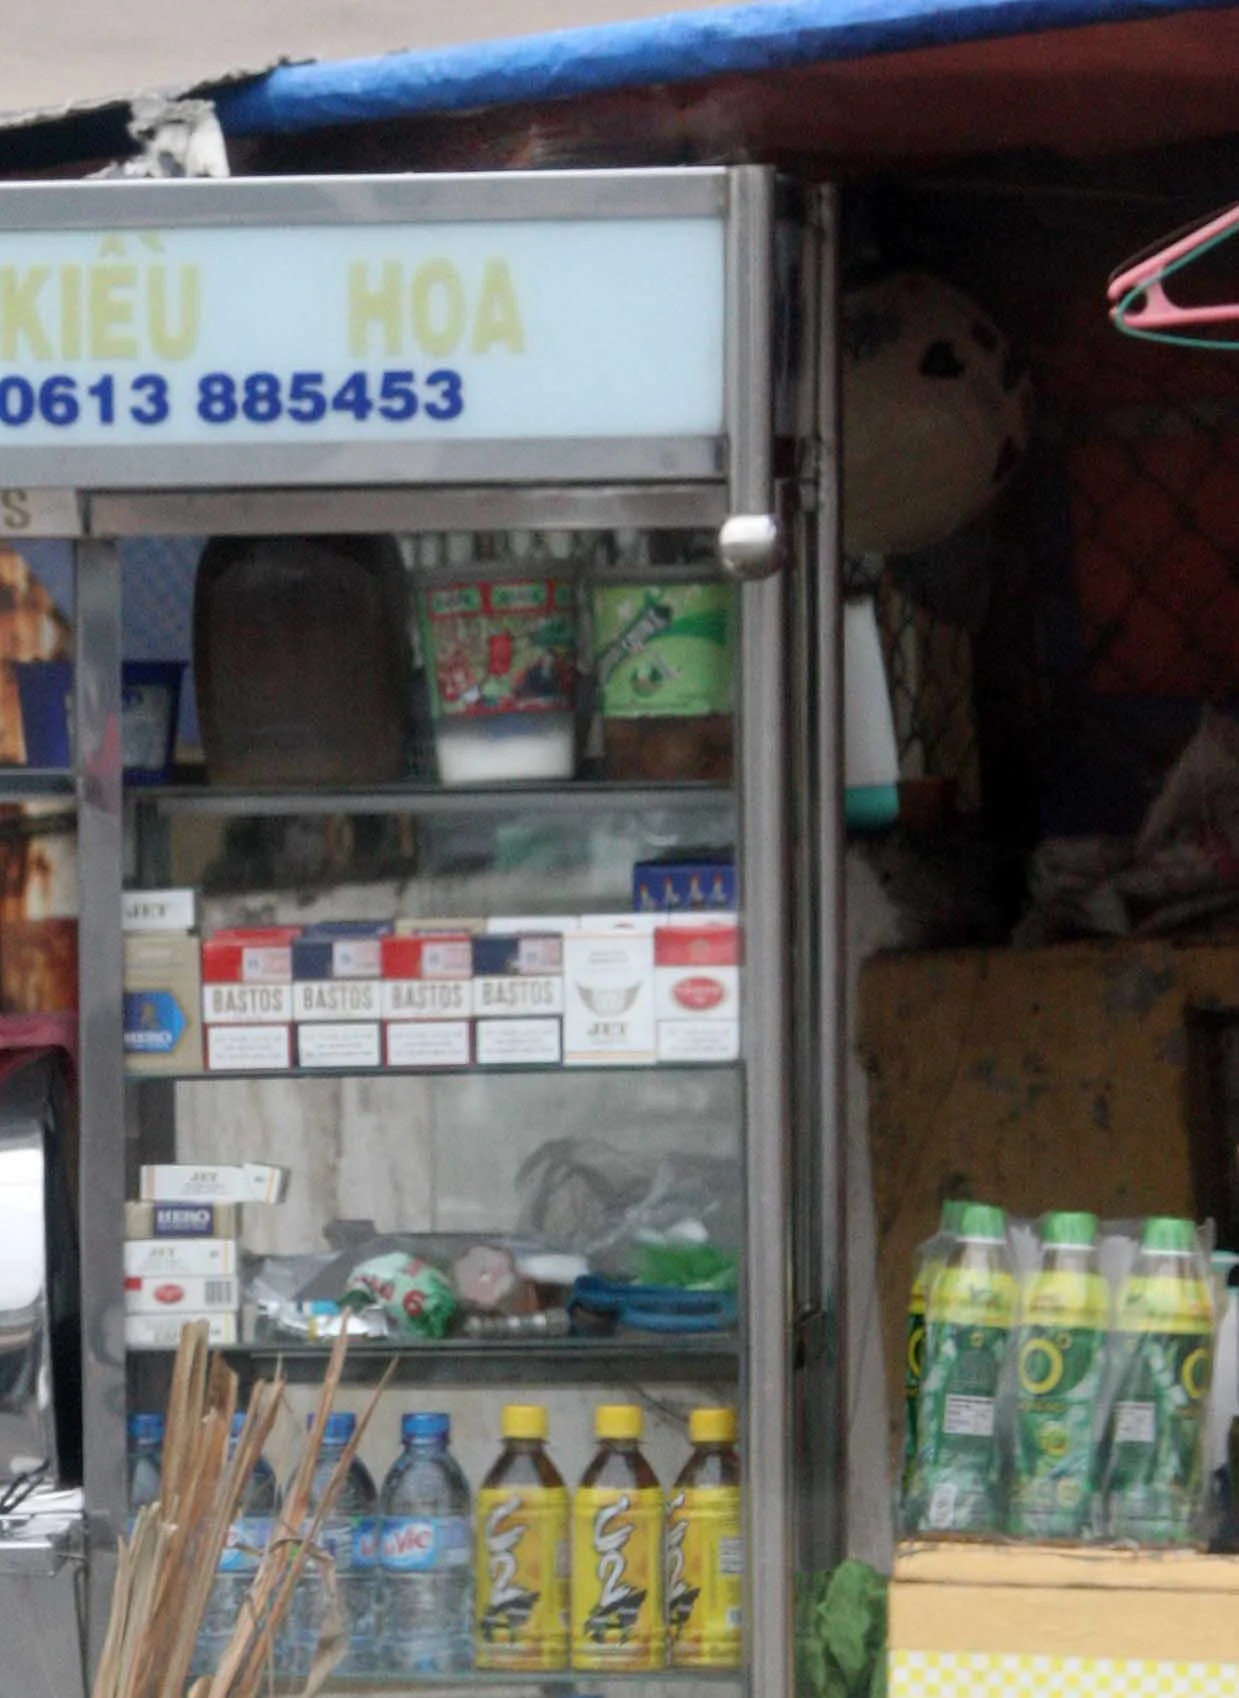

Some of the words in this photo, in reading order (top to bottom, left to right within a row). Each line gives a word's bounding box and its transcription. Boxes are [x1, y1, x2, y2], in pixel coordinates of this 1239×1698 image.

[346, 257, 526, 359] HOA
[196, 369, 466, 424] 885453
[212, 987, 284, 1016] BASTOS
[302, 985, 373, 1012] BASTOS
[391, 983, 463, 1011] BASTOS
[482, 979, 554, 1006] BASTOS
